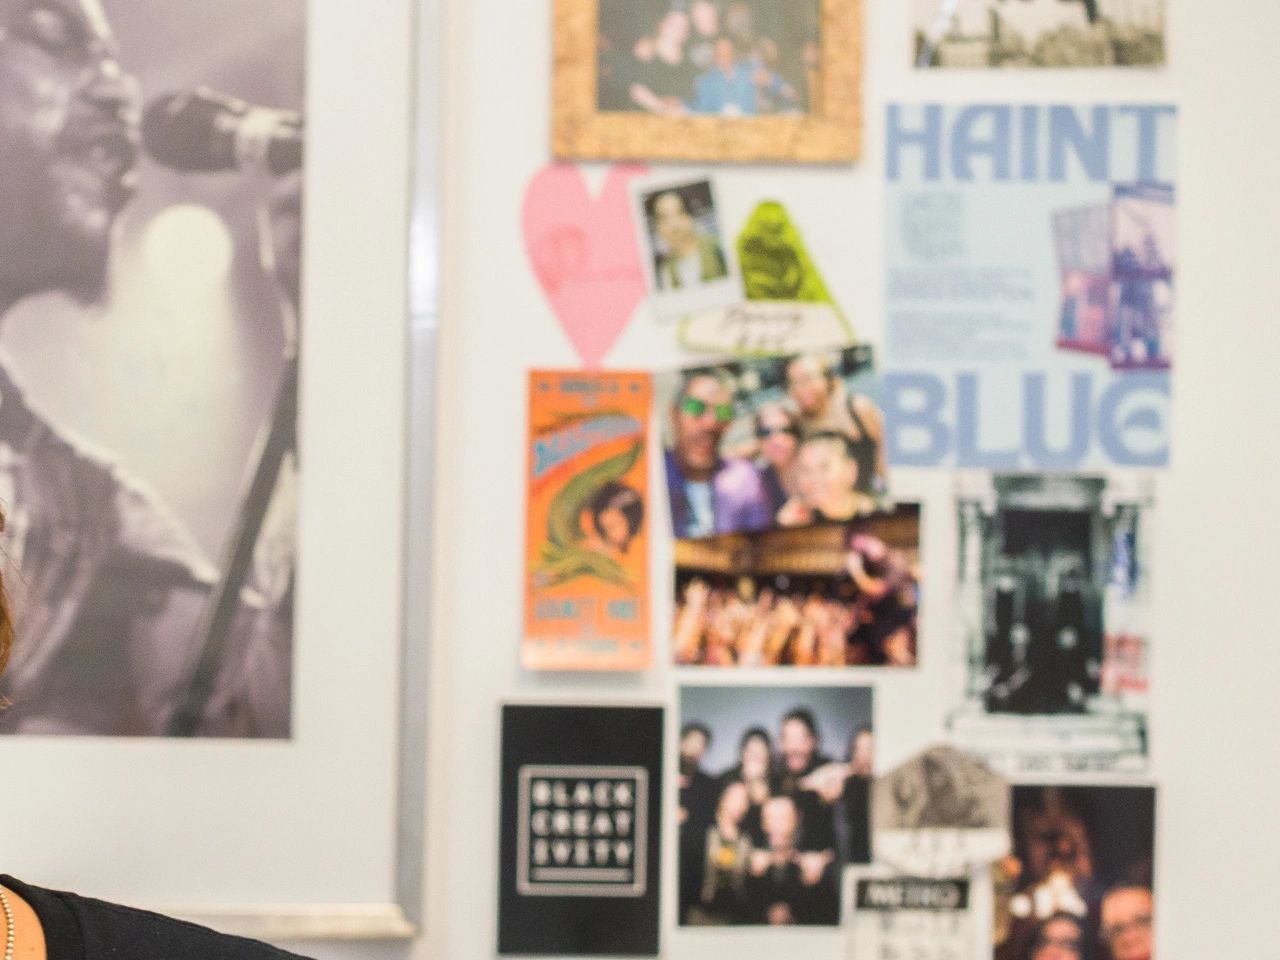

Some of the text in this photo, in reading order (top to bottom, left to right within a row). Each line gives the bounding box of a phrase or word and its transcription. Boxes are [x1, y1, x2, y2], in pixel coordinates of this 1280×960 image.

[885, 103, 1176, 183] HAINT
[531, 780, 633, 808] BLACK
[530, 808, 632, 837] CREAT
